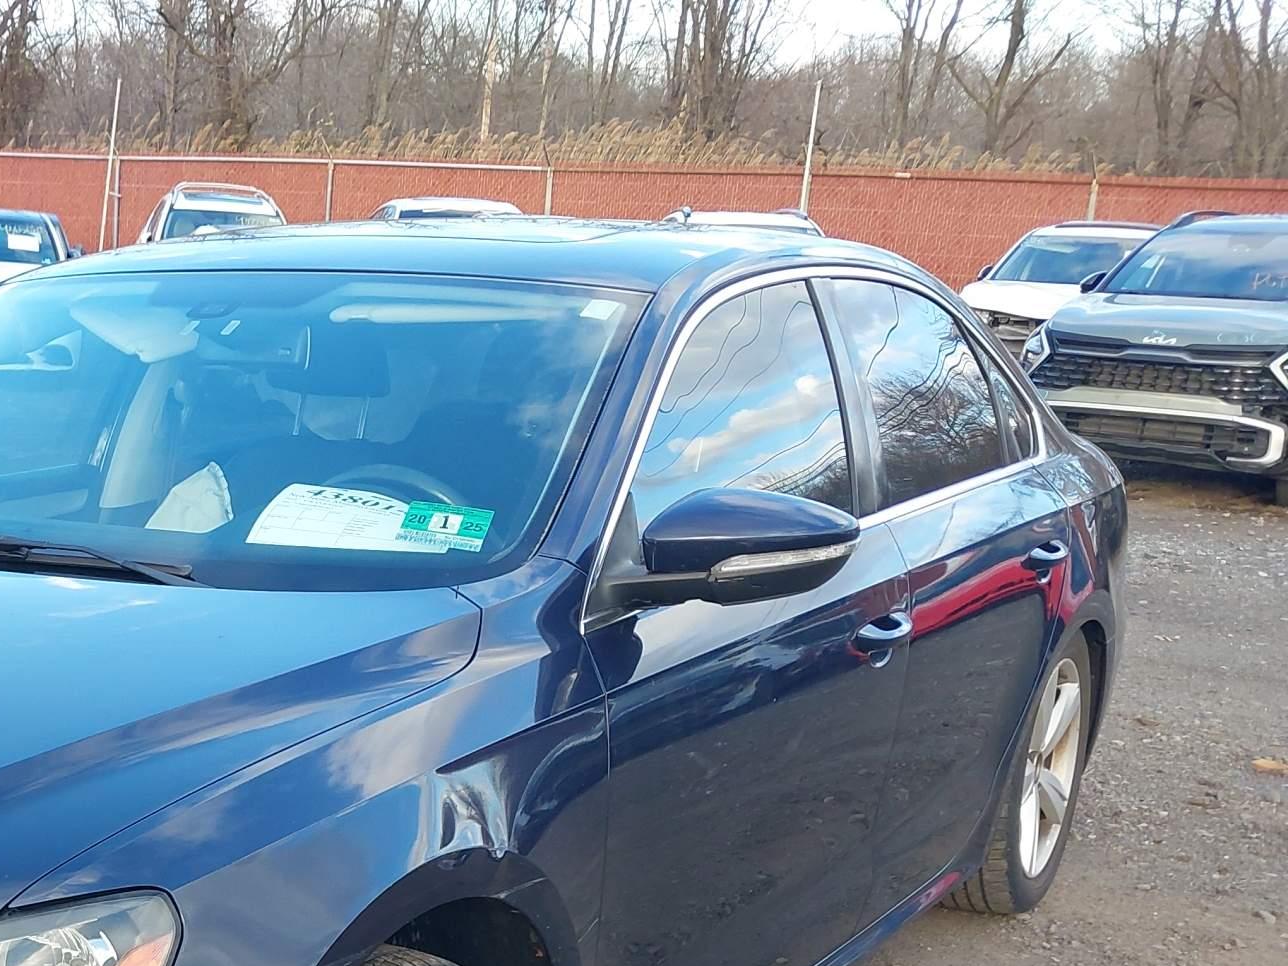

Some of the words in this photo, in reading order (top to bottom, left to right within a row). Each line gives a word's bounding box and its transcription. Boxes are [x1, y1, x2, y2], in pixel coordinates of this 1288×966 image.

[408, 513, 427, 525] 20
[439, 515, 450, 529] 1
[462, 521, 484, 532] 25
